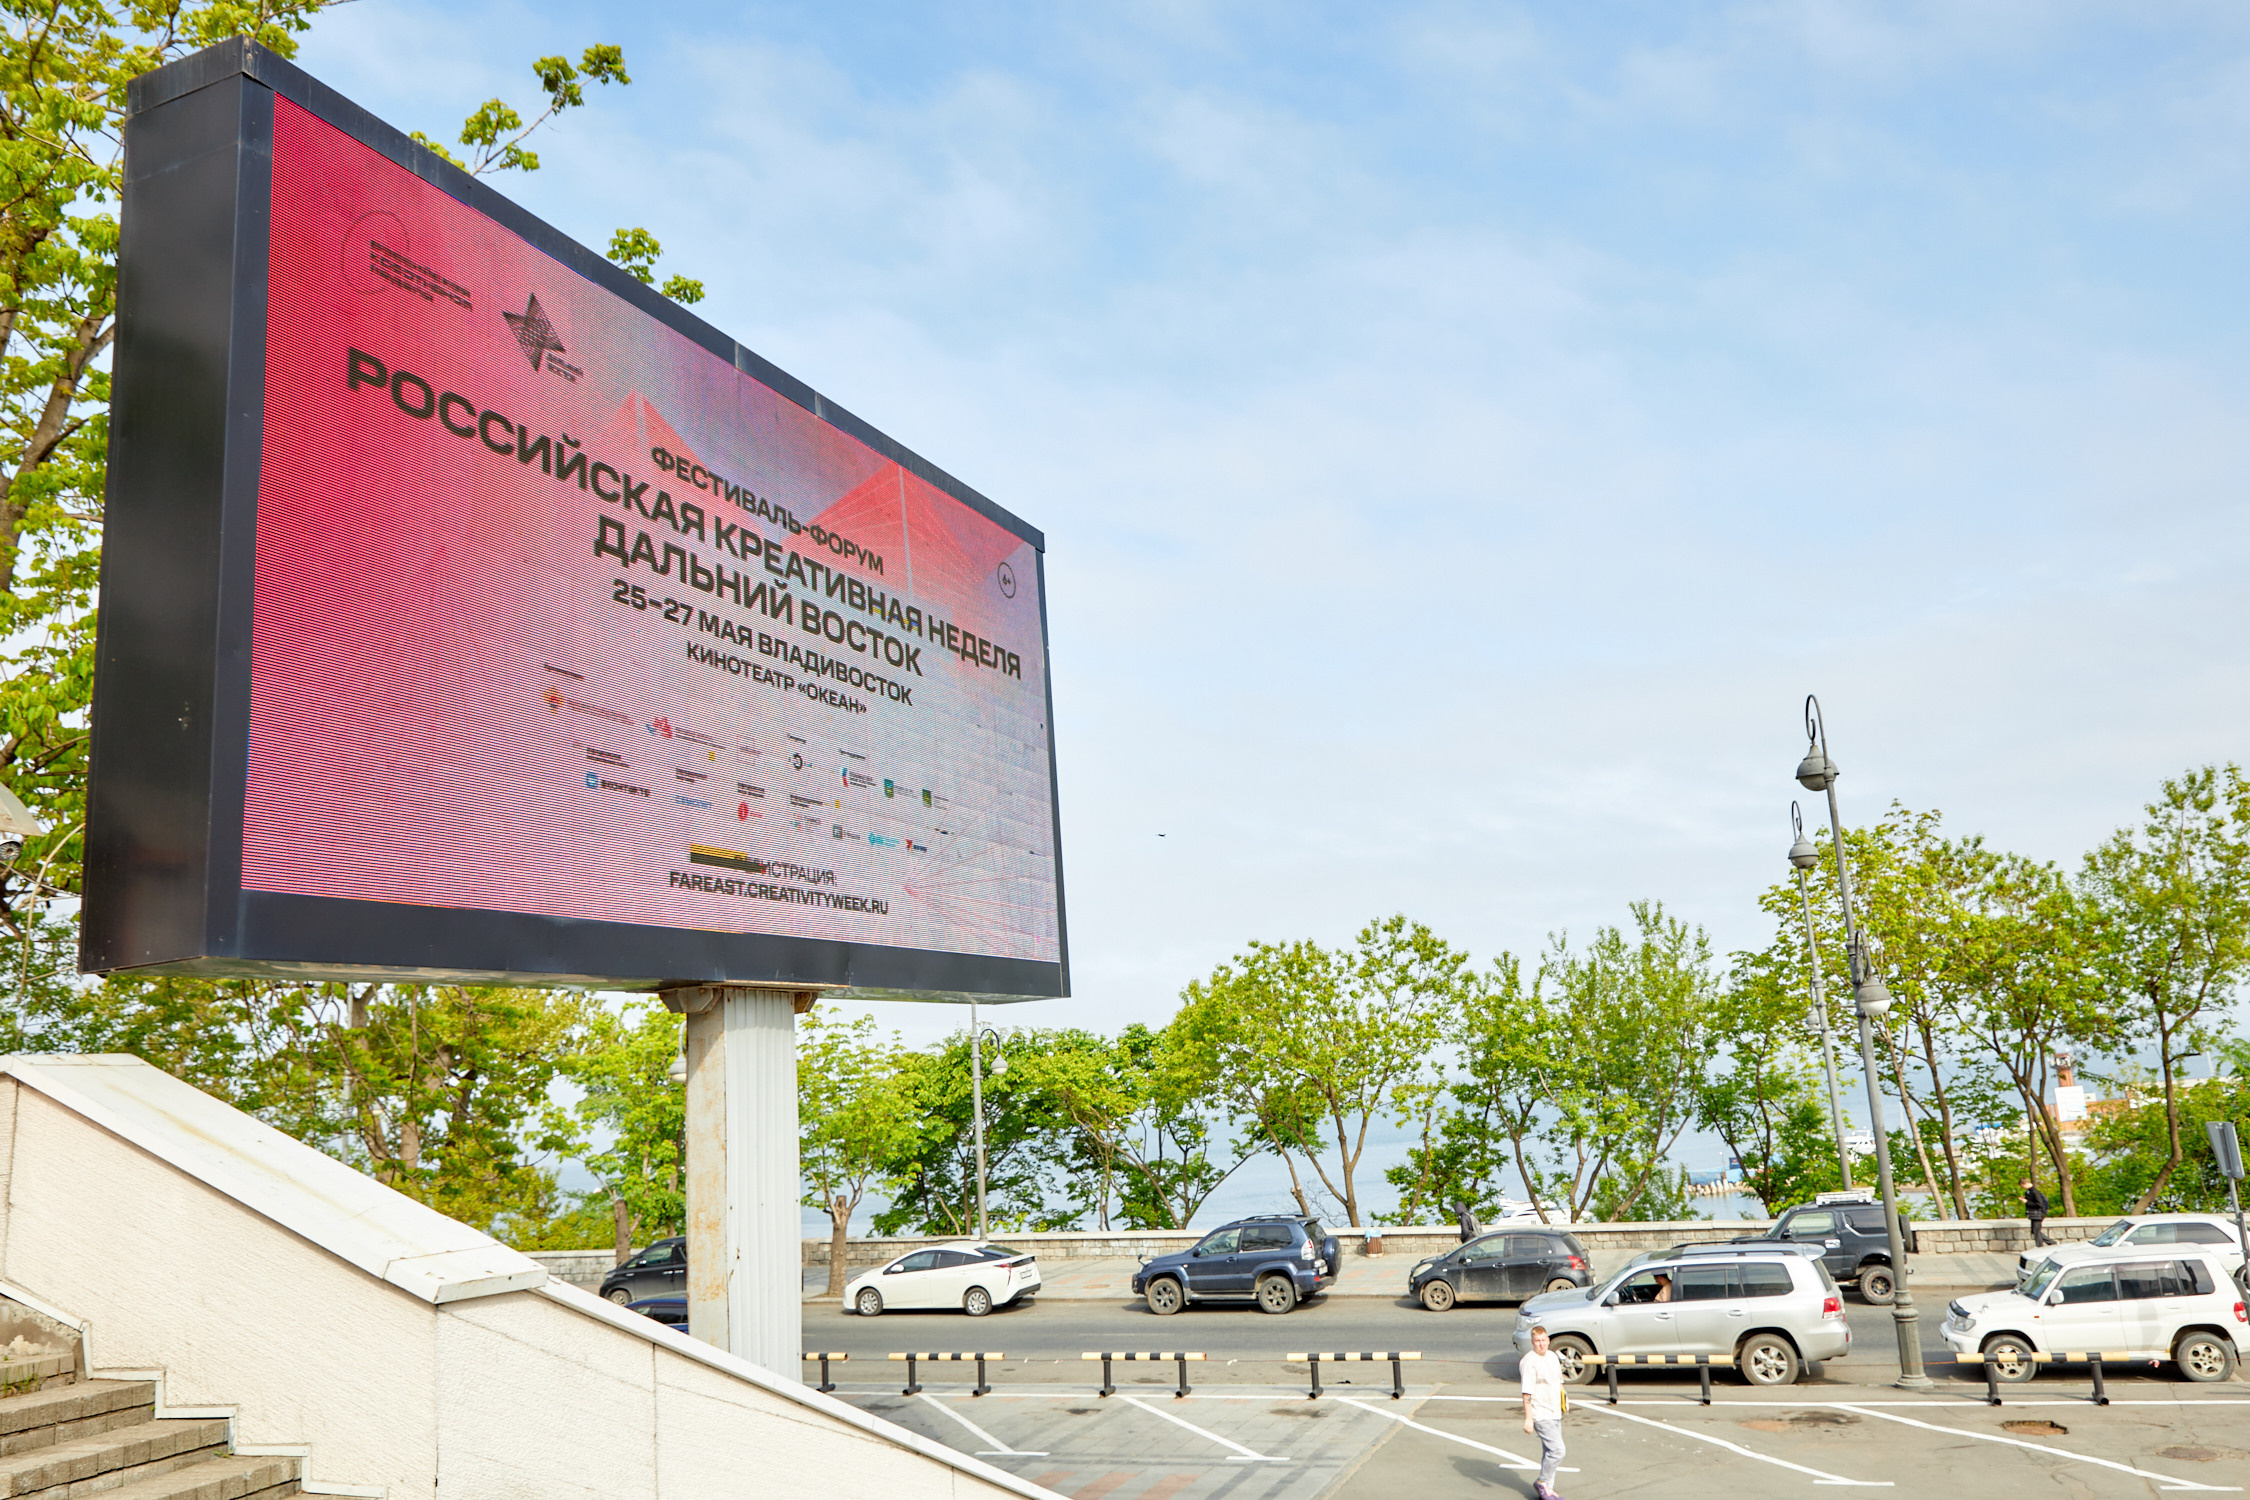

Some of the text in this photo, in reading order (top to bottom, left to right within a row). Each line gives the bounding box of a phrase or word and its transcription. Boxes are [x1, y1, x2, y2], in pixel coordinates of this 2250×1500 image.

[347, 346, 1021, 680] РОССИЙСКАЯ КРЕАТИВНАЯ НЕДЕЛЯ
[651, 447, 883, 574] ФЕСТИВАЛЬ-ФОРУМ
[593, 514, 922, 677] ДАЛЬНИЙ ВОСТОК
[686, 641, 868, 714] КИНОТЕАТР «ОКЕАН»
[698, 610, 752, 649] МАЯ
[758, 632, 912, 706] ВЛАДИВОСТОК
[669, 870, 889, 915] FAREAST.CREATIVITYWEEK.RU
